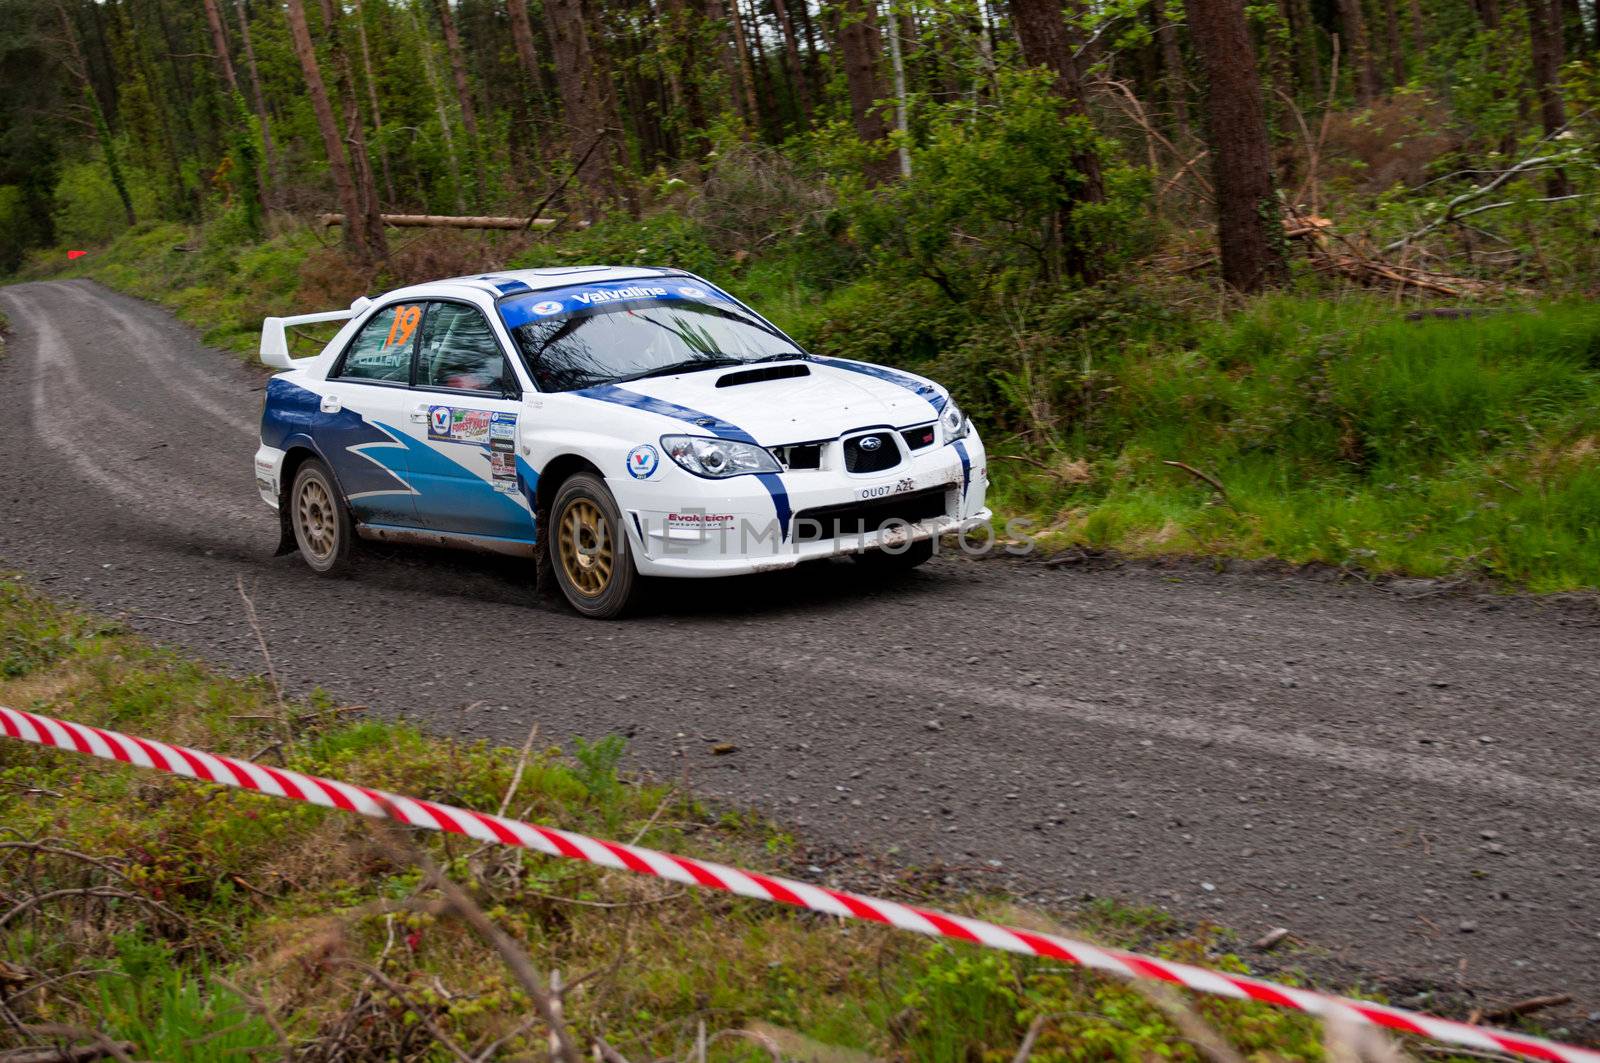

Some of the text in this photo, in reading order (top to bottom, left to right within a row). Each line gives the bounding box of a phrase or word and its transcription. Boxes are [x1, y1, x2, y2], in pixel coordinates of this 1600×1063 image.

[571, 286, 667, 304] Valvoline
[387, 305, 420, 346] 19
[862, 486, 890, 499] OU07
[668, 513, 735, 522] Evolution
